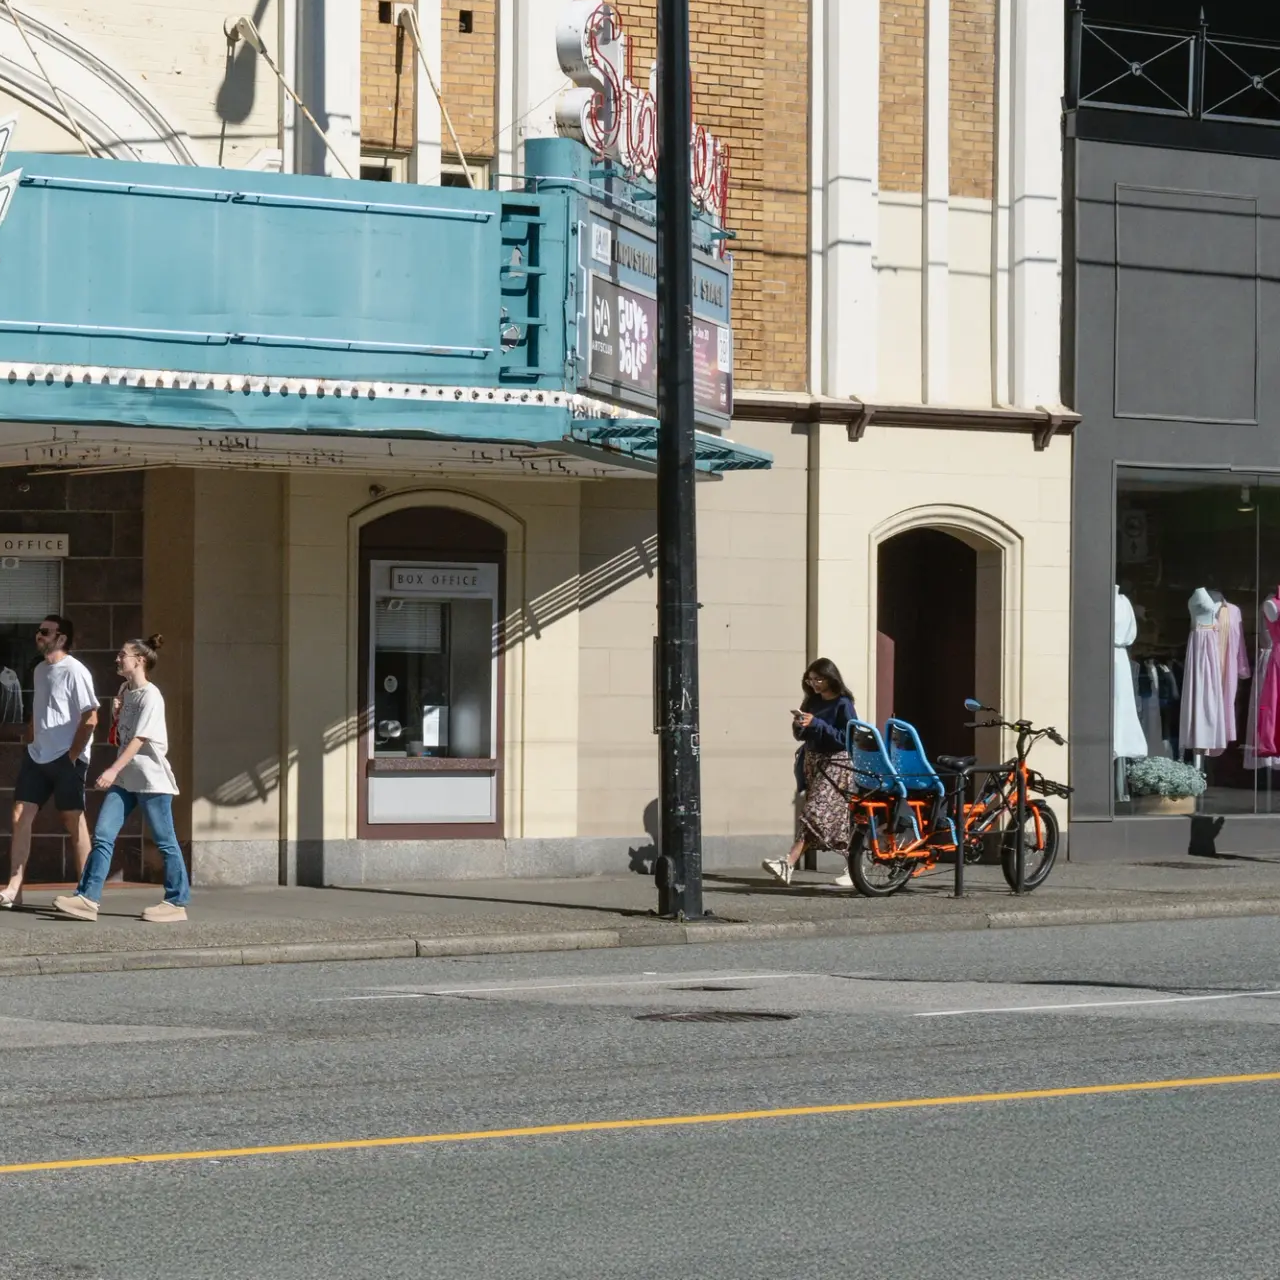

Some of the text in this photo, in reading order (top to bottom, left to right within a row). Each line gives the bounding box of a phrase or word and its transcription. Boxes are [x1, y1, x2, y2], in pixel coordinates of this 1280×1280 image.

[5, 540, 63, 550] OFFICE
[397, 574, 478, 586] BOX OFFICE
